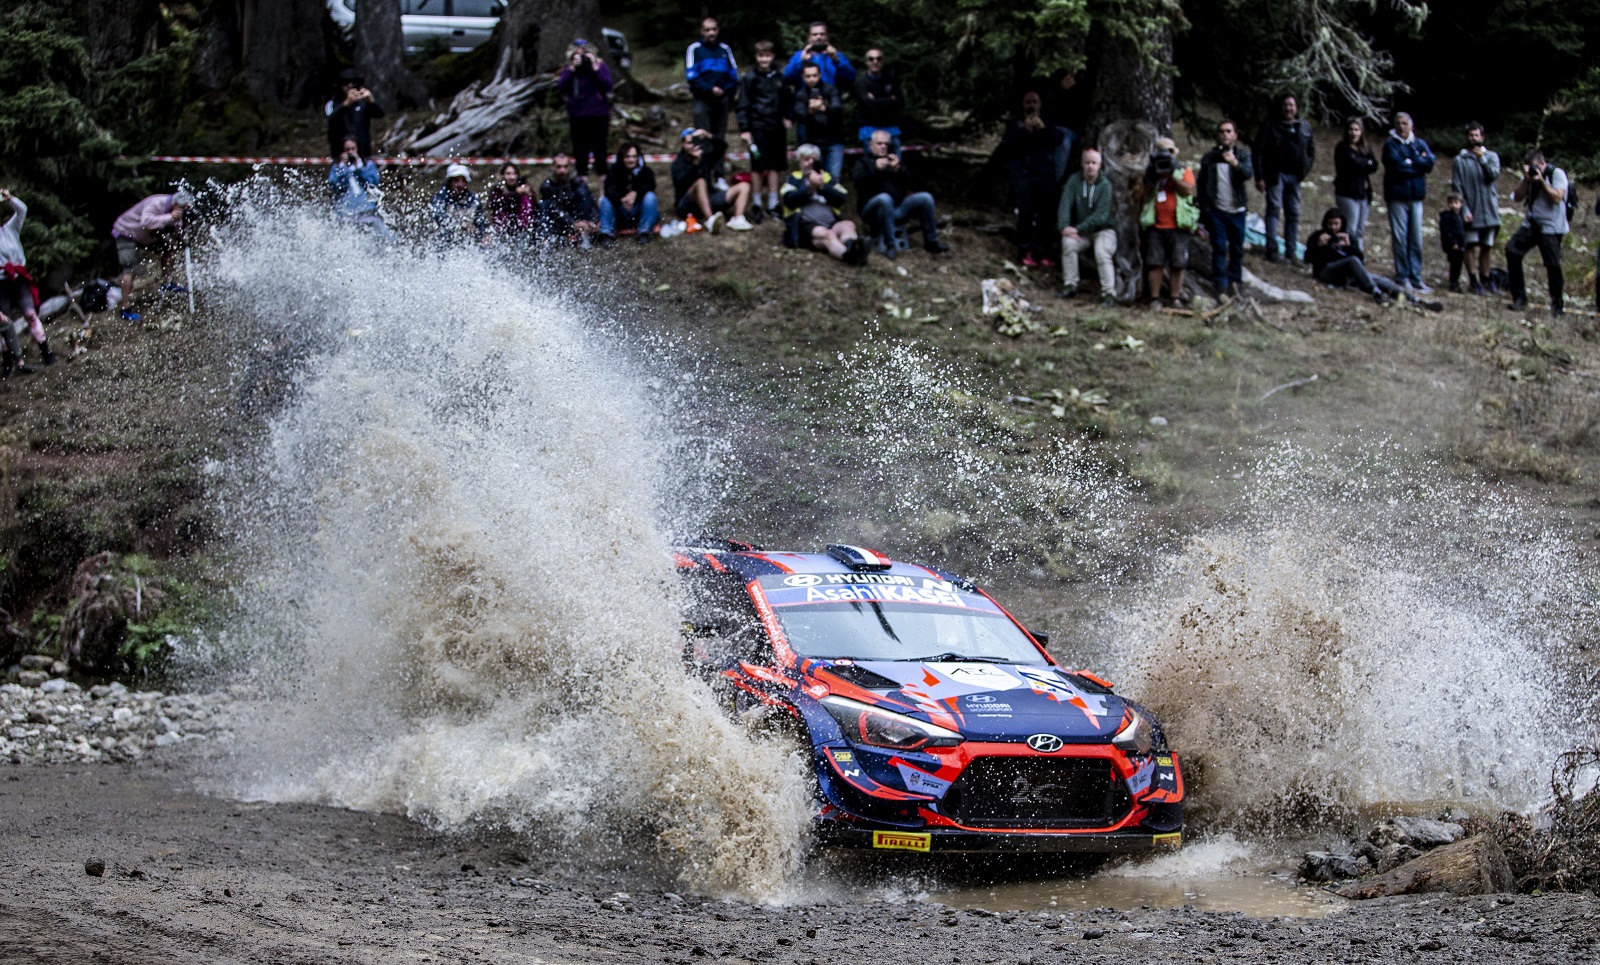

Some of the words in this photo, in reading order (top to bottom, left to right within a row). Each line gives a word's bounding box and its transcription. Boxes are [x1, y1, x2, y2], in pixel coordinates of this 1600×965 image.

[827, 573, 914, 586] HYUNDAI
[922, 578, 953, 593] N
[844, 769, 860, 777] N
[1159, 773, 1174, 781] N
[877, 833, 927, 849] PIRELLI
